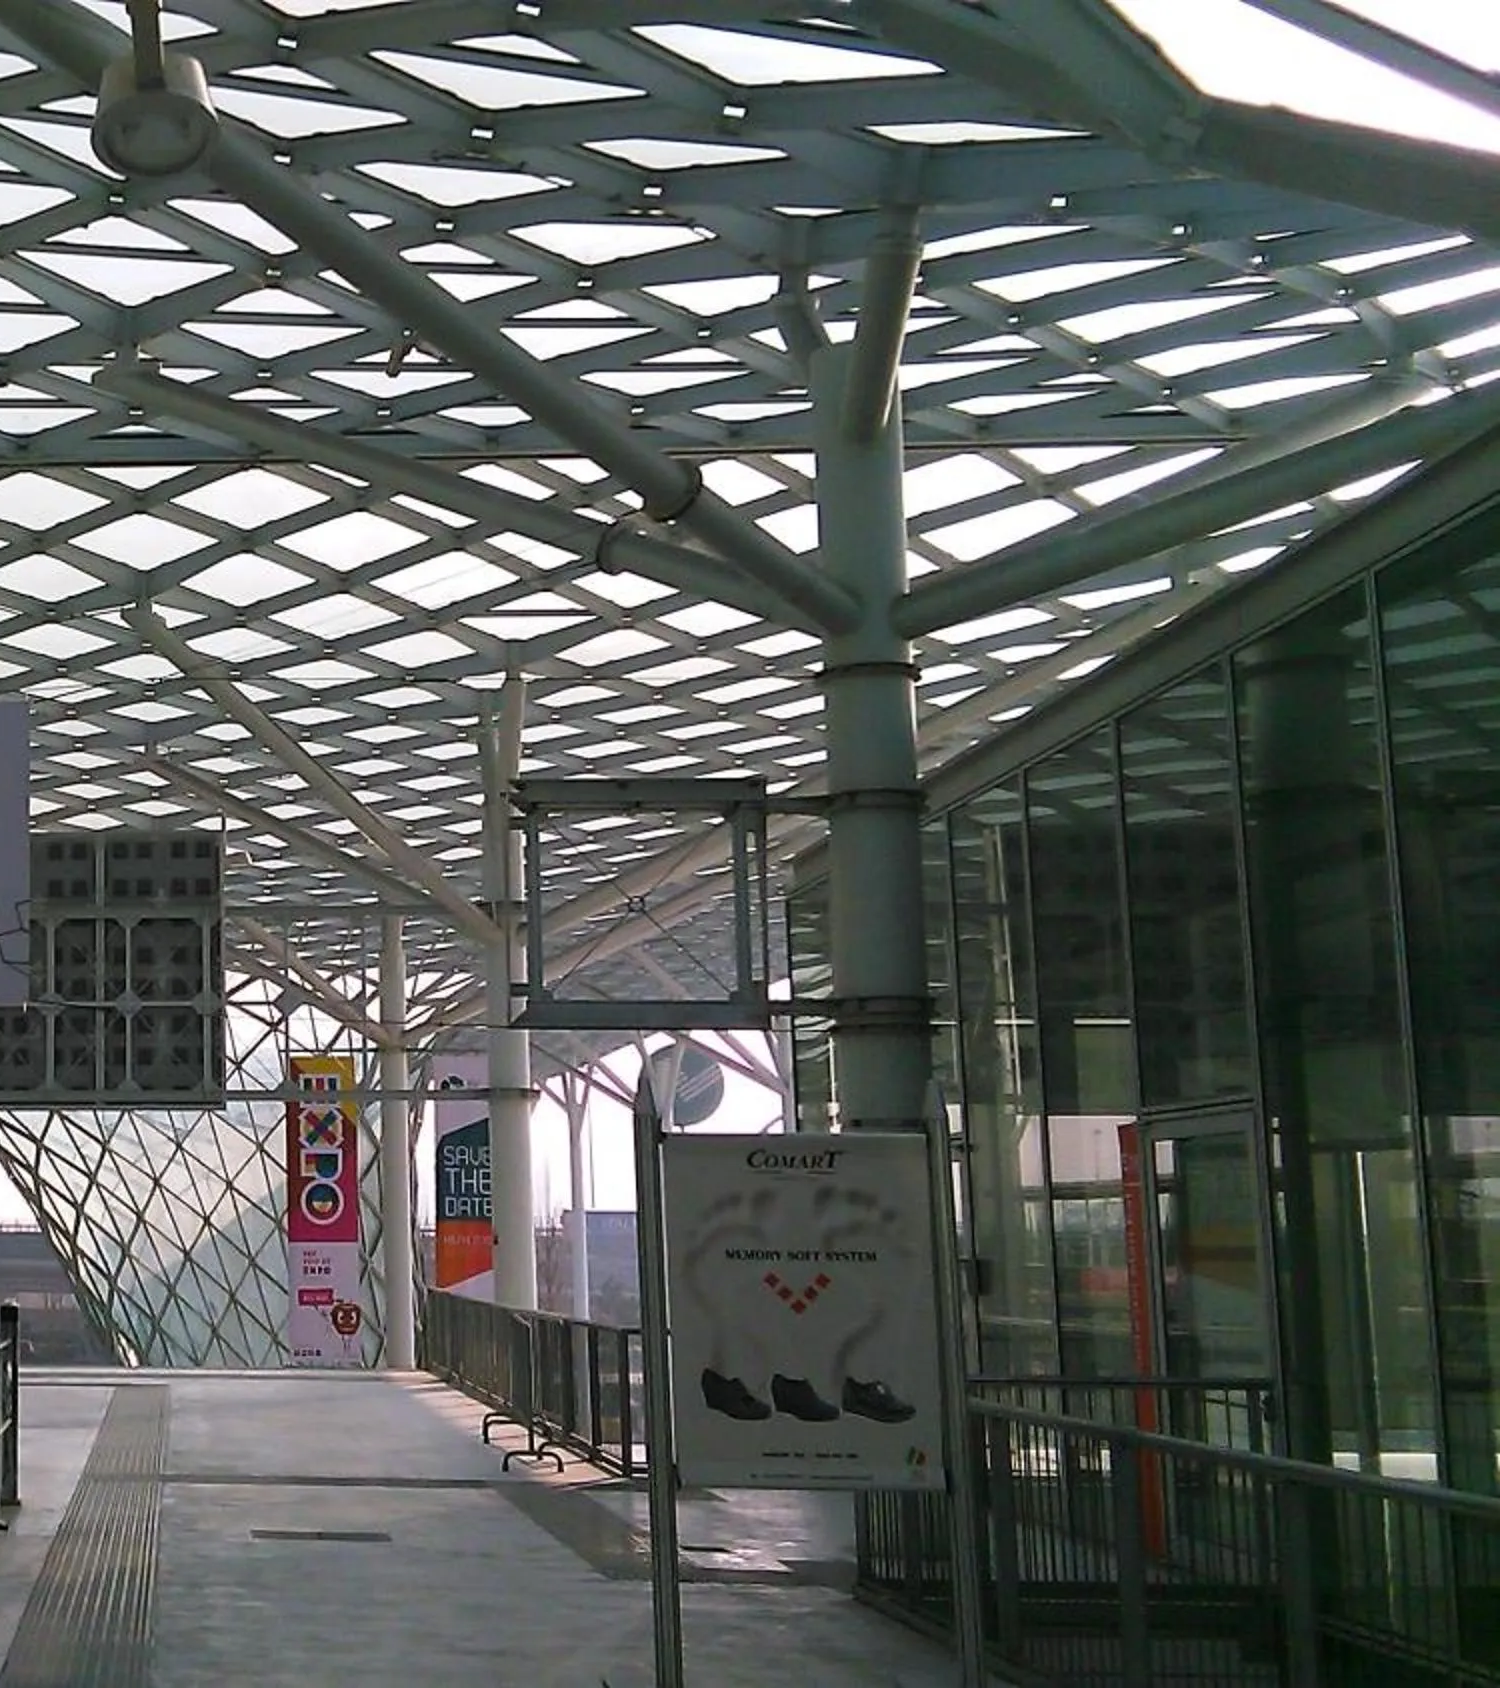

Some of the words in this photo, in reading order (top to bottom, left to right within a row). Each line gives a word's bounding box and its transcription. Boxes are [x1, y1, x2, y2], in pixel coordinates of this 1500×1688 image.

[298, 1073, 345, 1226] EXPO
[444, 1167, 493, 1195] THE
[725, 1249, 781, 1262] MEMORY
[786, 1250, 820, 1263] SOFT
[825, 1250, 877, 1263] SYSTEM
